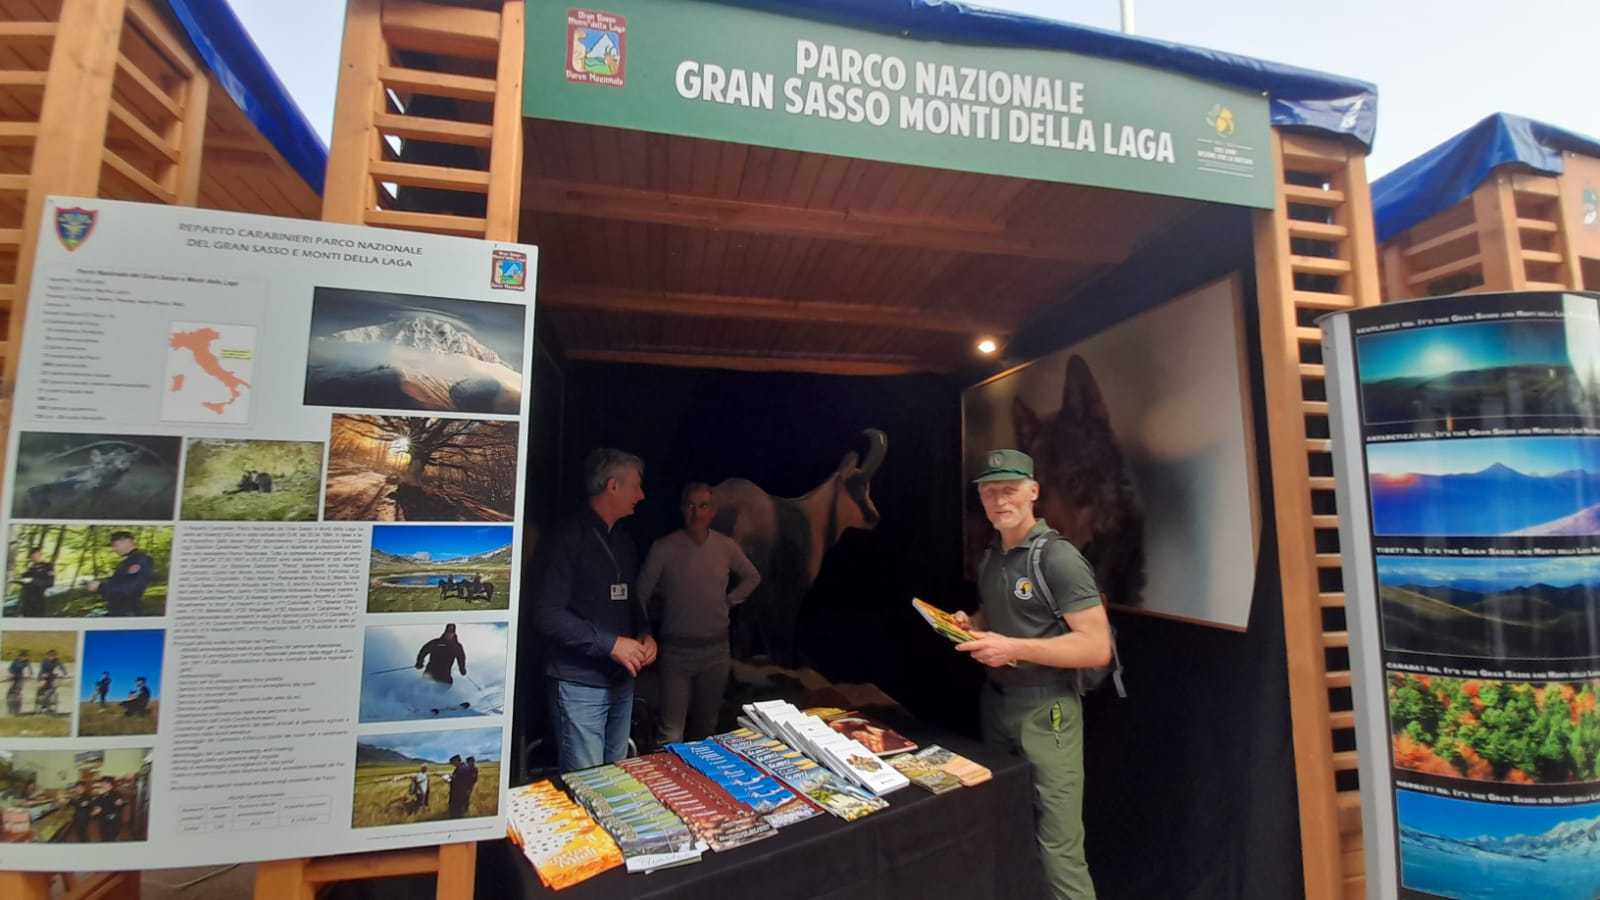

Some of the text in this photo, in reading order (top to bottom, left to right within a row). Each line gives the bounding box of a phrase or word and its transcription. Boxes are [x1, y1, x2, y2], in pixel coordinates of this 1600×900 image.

[796, 39, 1085, 115] PARCO NAZIONALE
[675, 60, 1175, 164] GRAN SASSO MONTI DELLA LAGA
[178, 222, 423, 256] REPARTO CARABINIERI PARCO NAZIONALE
[186, 238, 413, 269] DEL GRAN SASSO E MONTI DELLA LAGA
[1451, 314, 1475, 322] GRAN
[1461, 547, 1487, 555] GRAN
[1479, 668, 1504, 678] GRAN
[1487, 793, 1511, 802] GRAN
